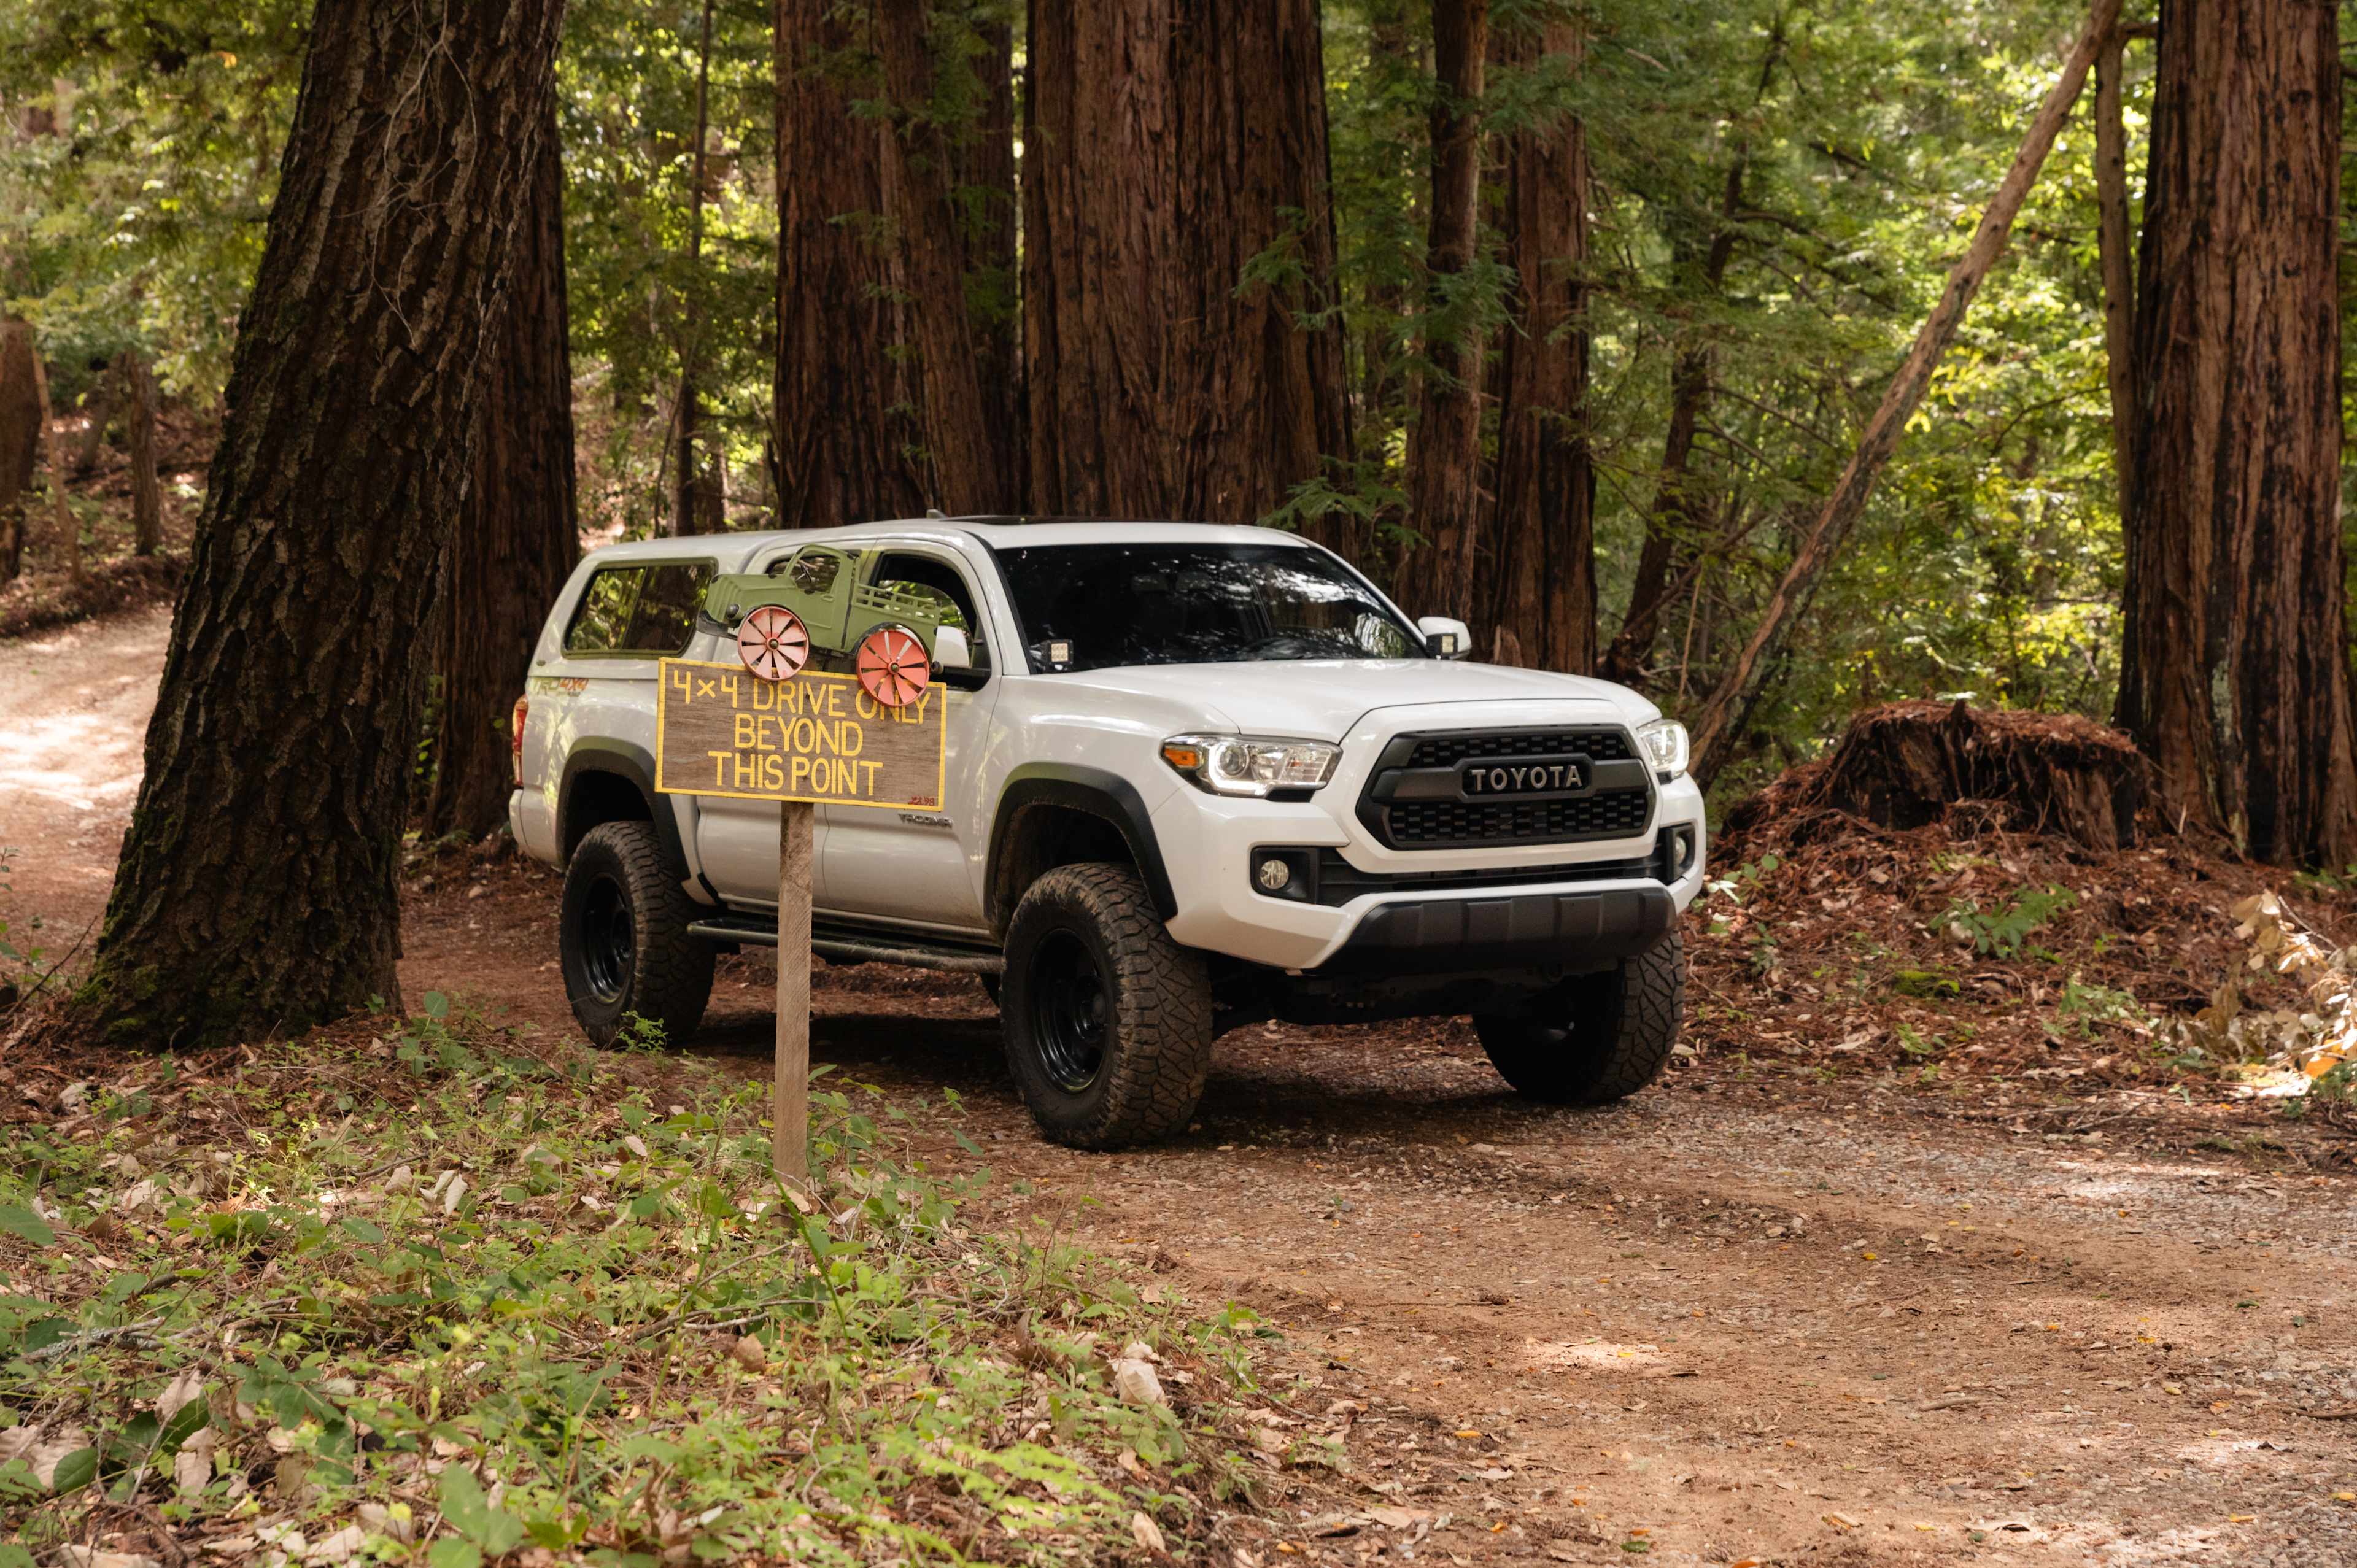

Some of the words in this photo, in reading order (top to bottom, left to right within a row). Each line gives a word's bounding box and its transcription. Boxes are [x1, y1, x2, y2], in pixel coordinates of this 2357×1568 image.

[753, 678, 846, 717] DRIVE
[734, 713, 863, 757] BEYOND
[708, 751, 783, 790] THIS
[791, 757, 883, 796] POINT
[1471, 765, 1582, 792] TOYOTA
